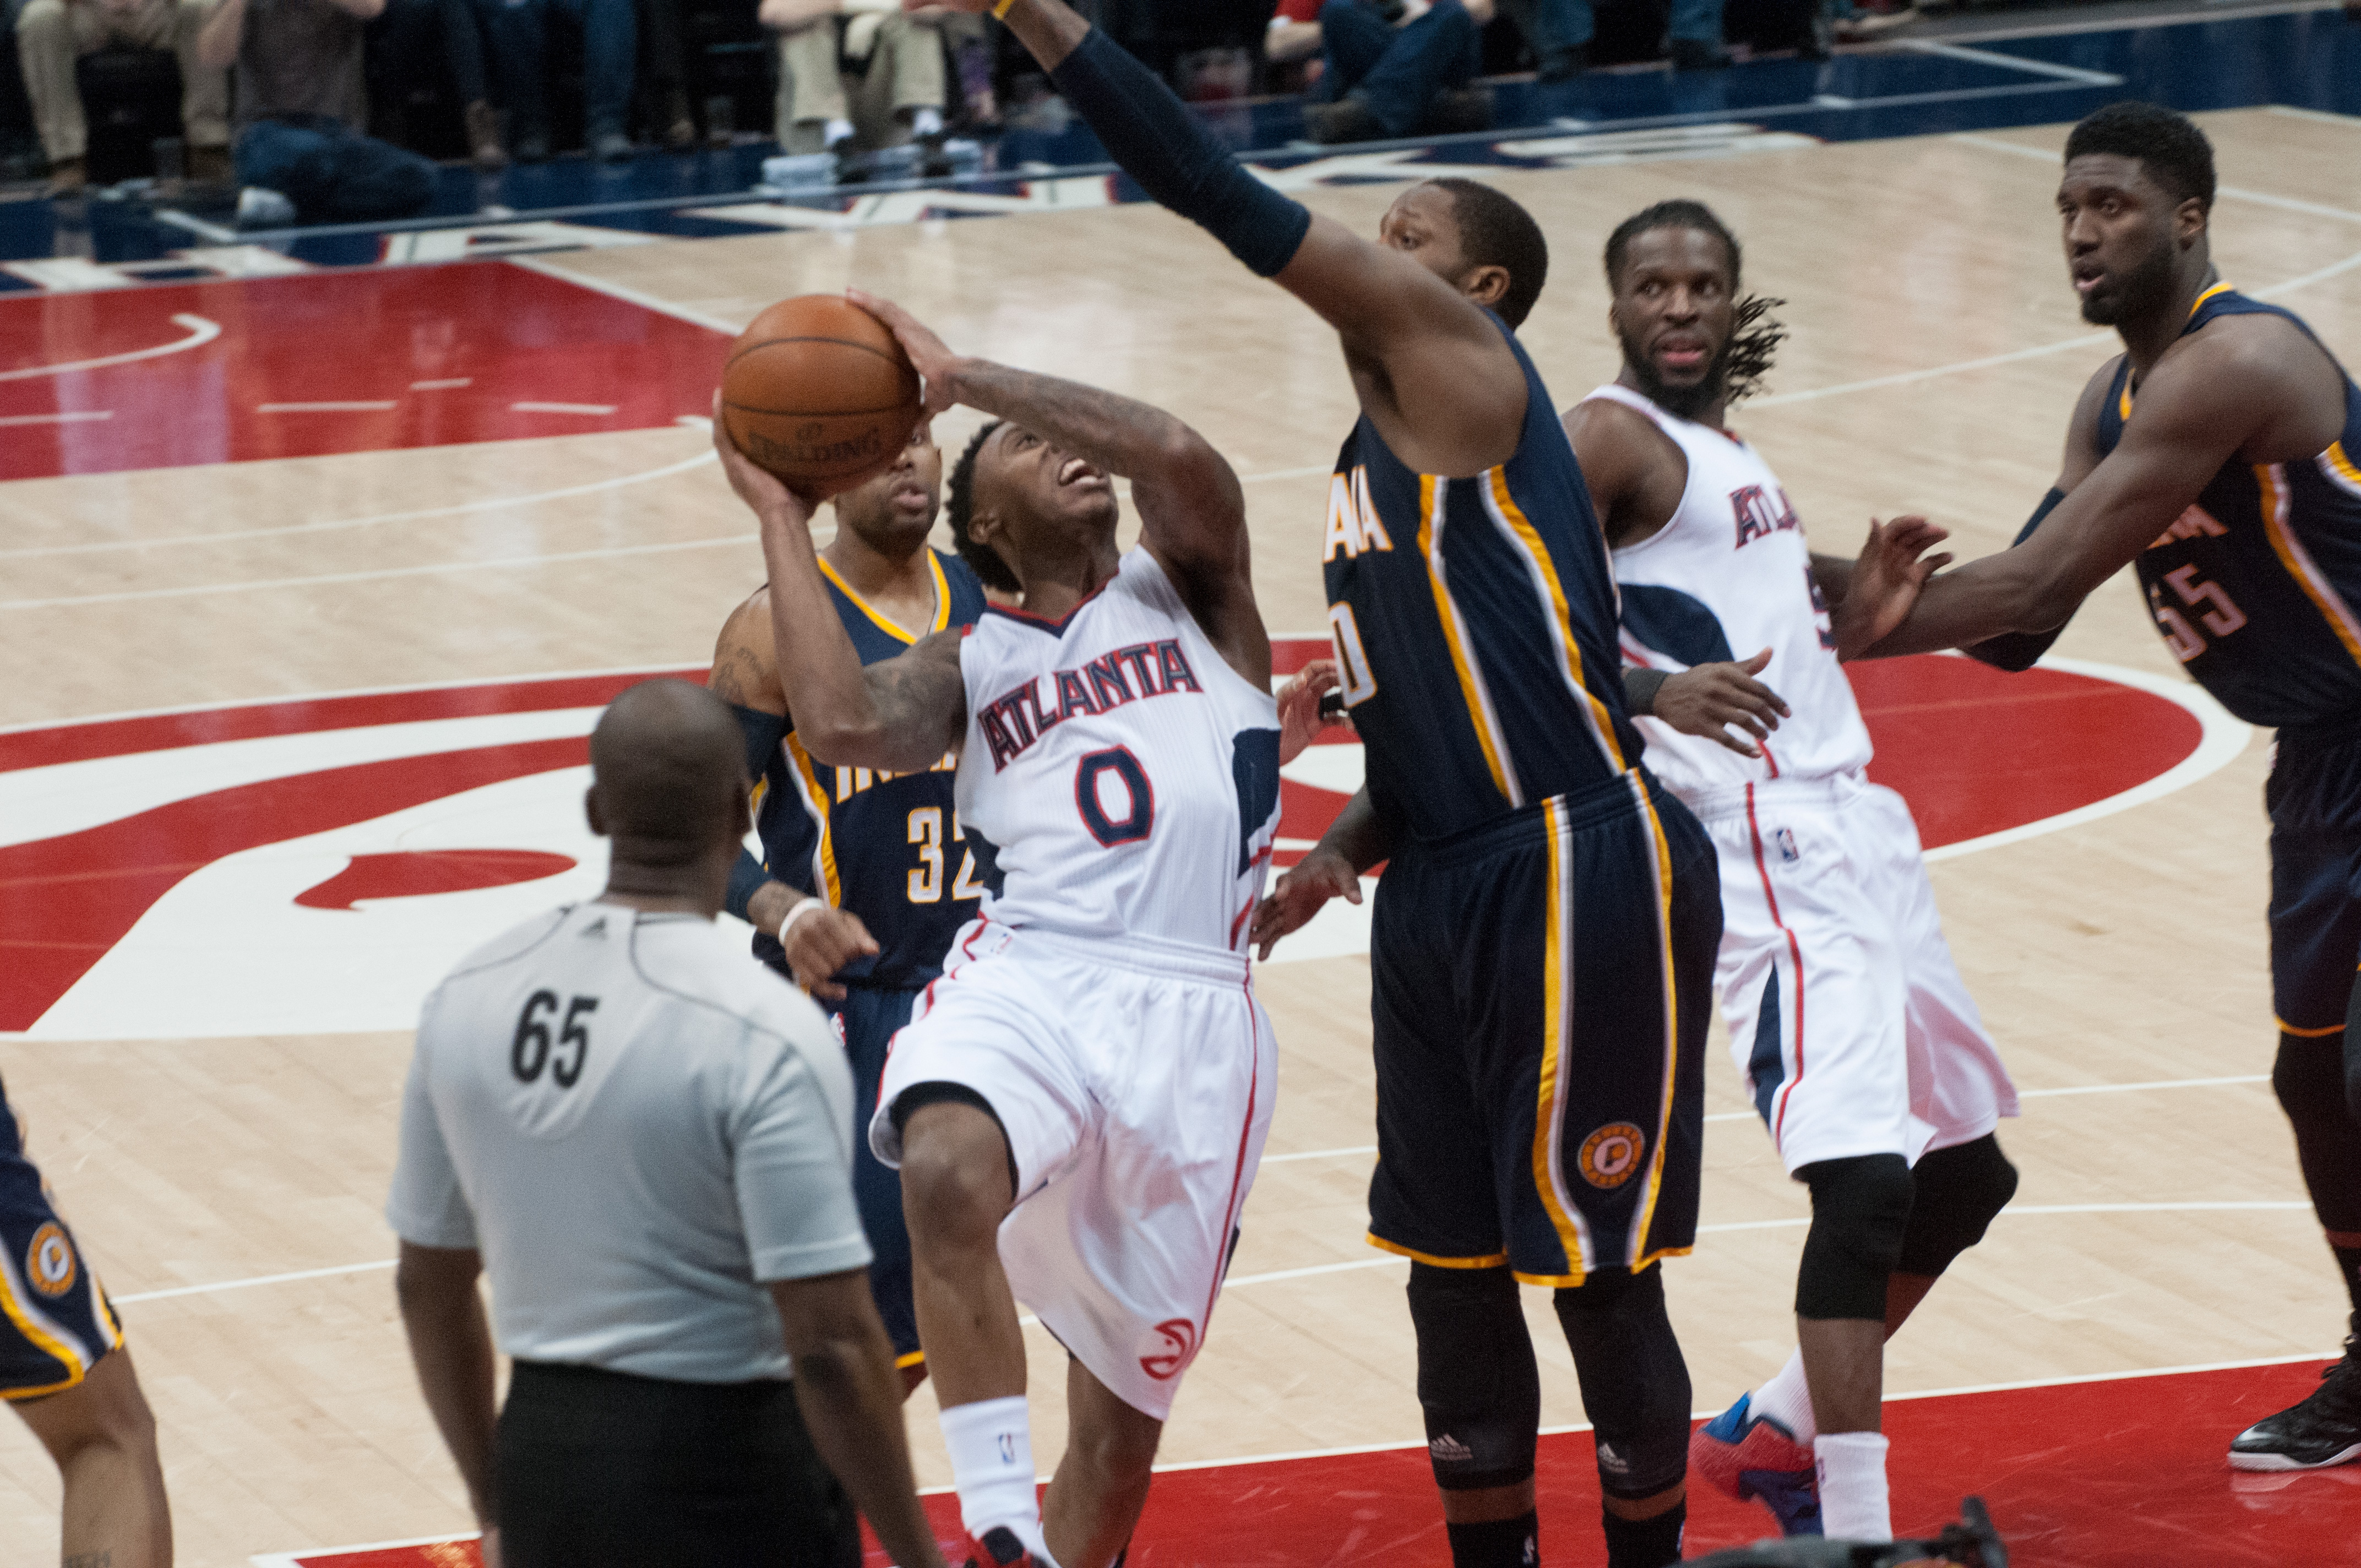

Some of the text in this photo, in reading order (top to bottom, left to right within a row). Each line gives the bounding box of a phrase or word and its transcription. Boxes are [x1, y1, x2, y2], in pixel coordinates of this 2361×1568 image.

[2150, 563, 2248, 663] 55
[977, 638, 1204, 775] ATLANTA
[1074, 744, 1155, 848] 0
[510, 988, 600, 1088] 65
